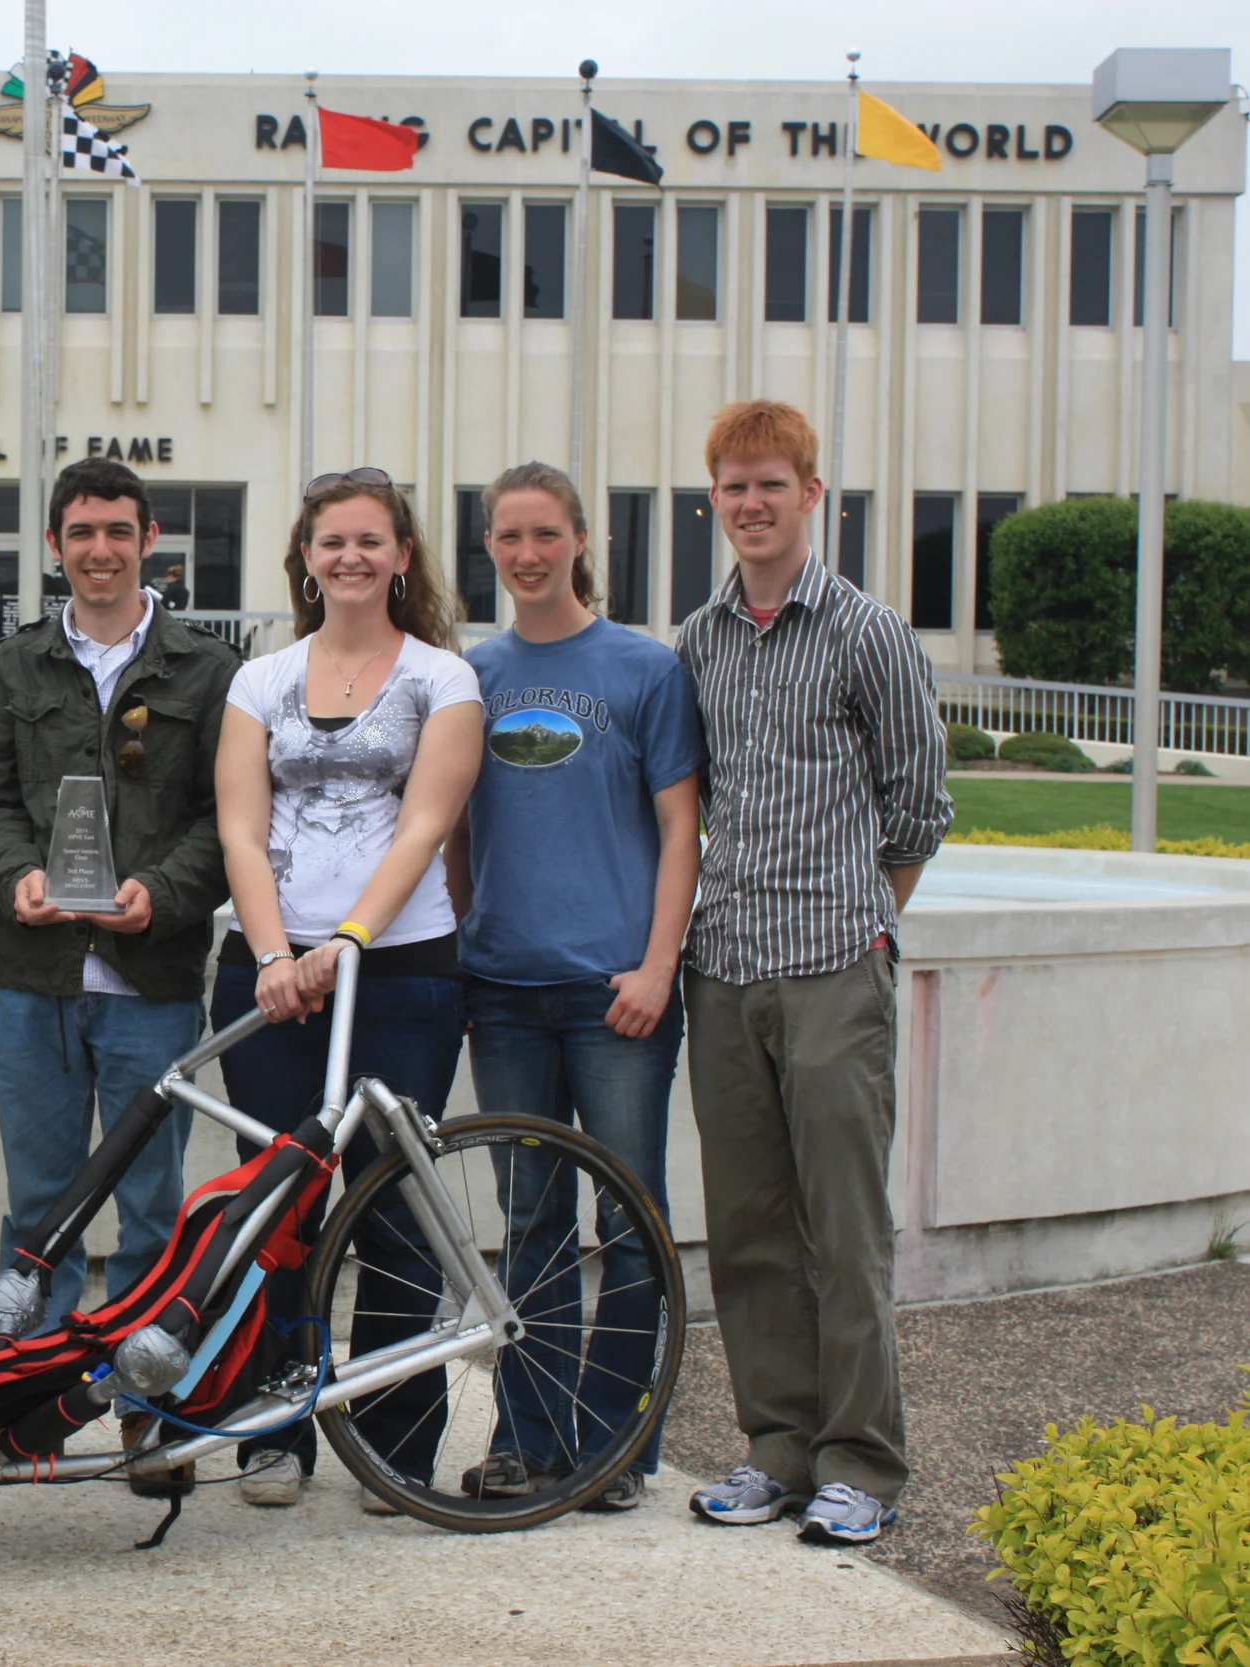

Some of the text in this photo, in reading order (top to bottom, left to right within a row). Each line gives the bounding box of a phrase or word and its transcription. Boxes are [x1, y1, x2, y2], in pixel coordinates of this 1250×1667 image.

[467, 118, 657, 154] CAPIL
[687, 120, 751, 157] OF
[781, 121, 866, 158] TH
[42, 436, 68, 459] F
[88, 437, 172, 463] FAME
[68, 807, 95, 818] ASME
